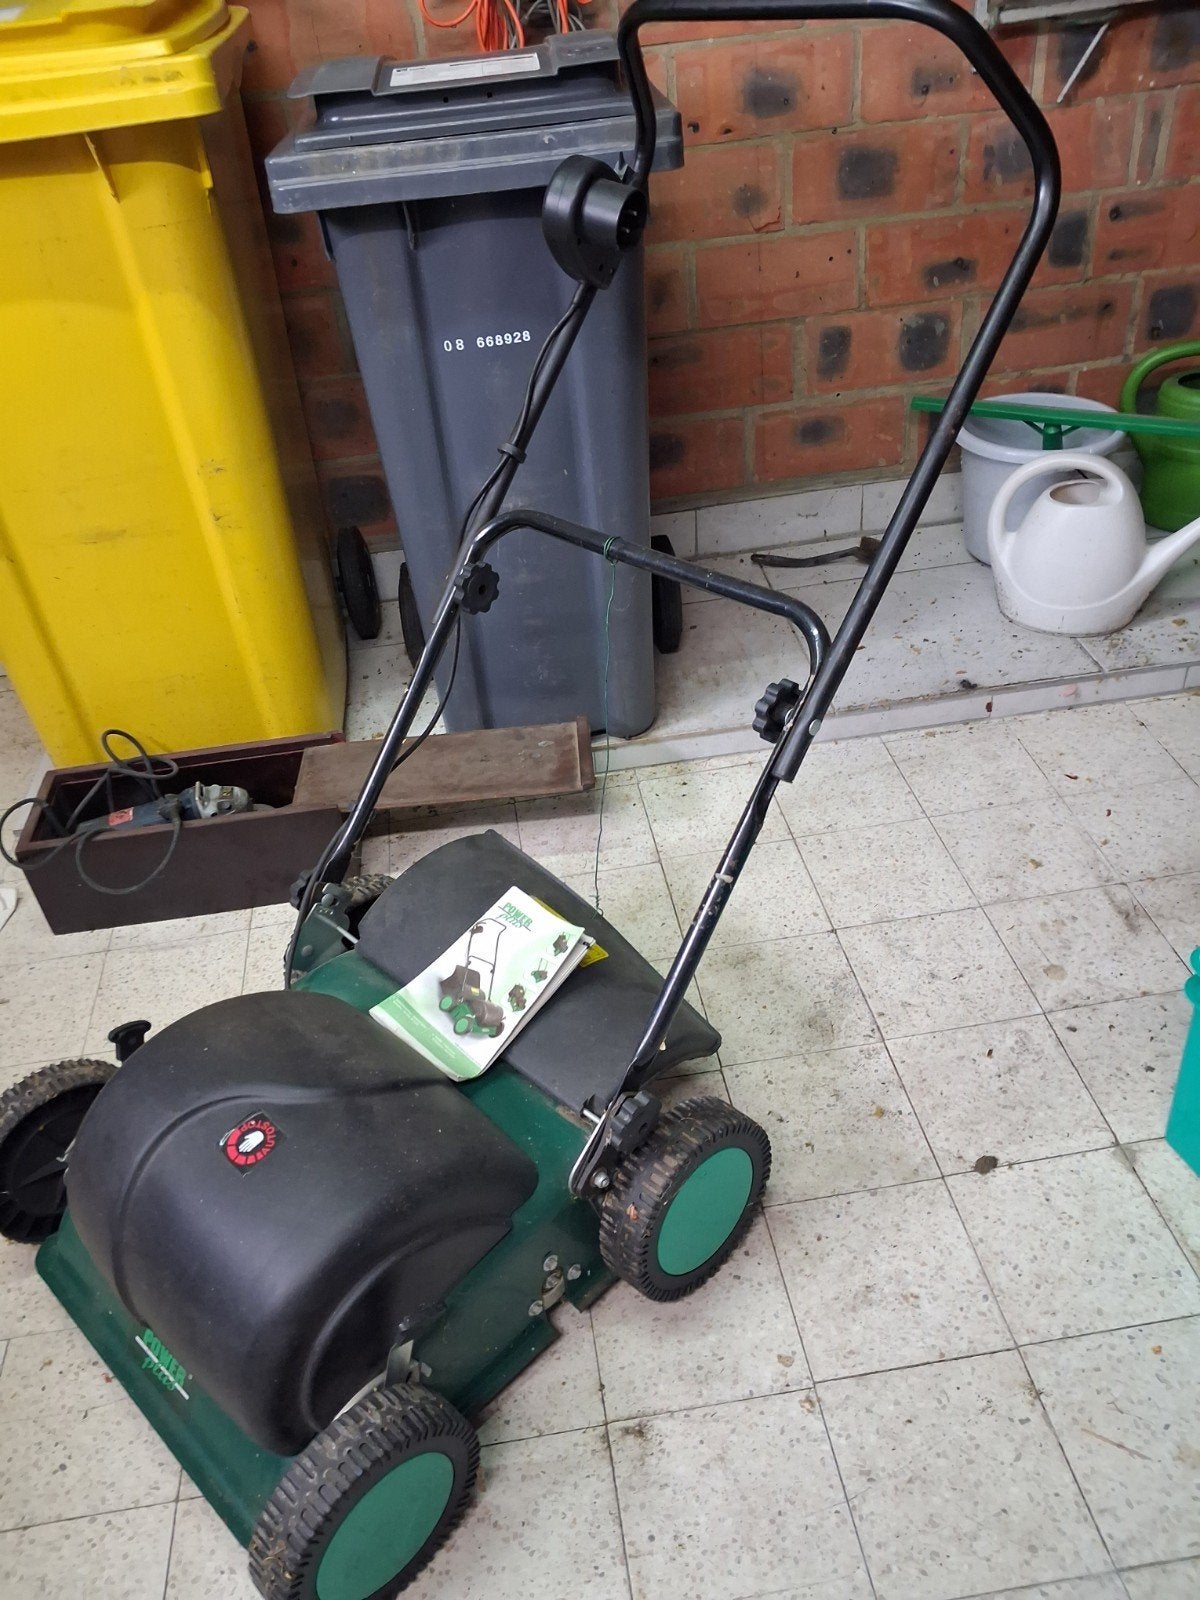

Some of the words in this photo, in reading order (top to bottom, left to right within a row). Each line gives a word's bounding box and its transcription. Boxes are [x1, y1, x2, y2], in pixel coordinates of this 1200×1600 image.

[476, 330, 531, 348] 668928
[502, 902, 533, 927] POWER
[240, 1120, 277, 1156] AUTOSTOP
[141, 1356, 176, 1391] plus
[143, 1328, 186, 1389] POWER
